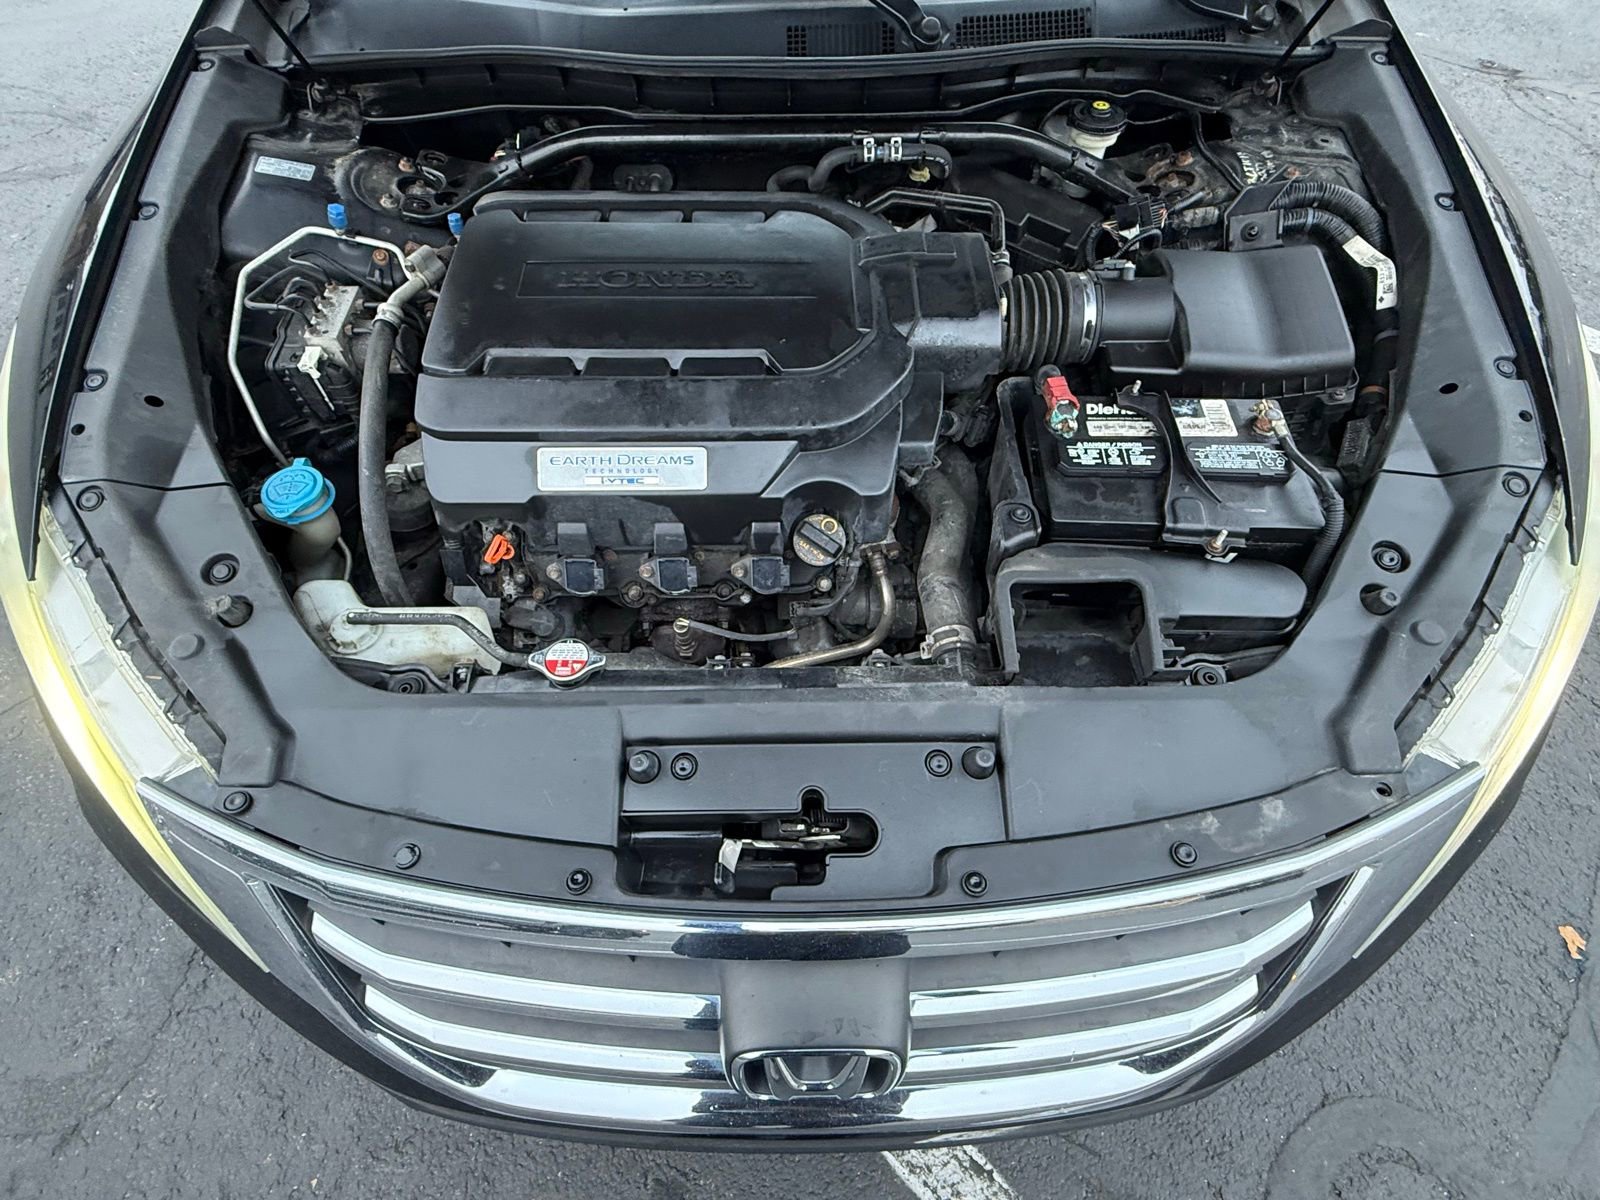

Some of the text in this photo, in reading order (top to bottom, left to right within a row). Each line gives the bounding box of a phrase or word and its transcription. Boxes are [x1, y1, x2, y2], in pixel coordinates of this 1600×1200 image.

[556, 269, 755, 288] HONDA
[550, 454, 695, 466] EARTH DREAMS
